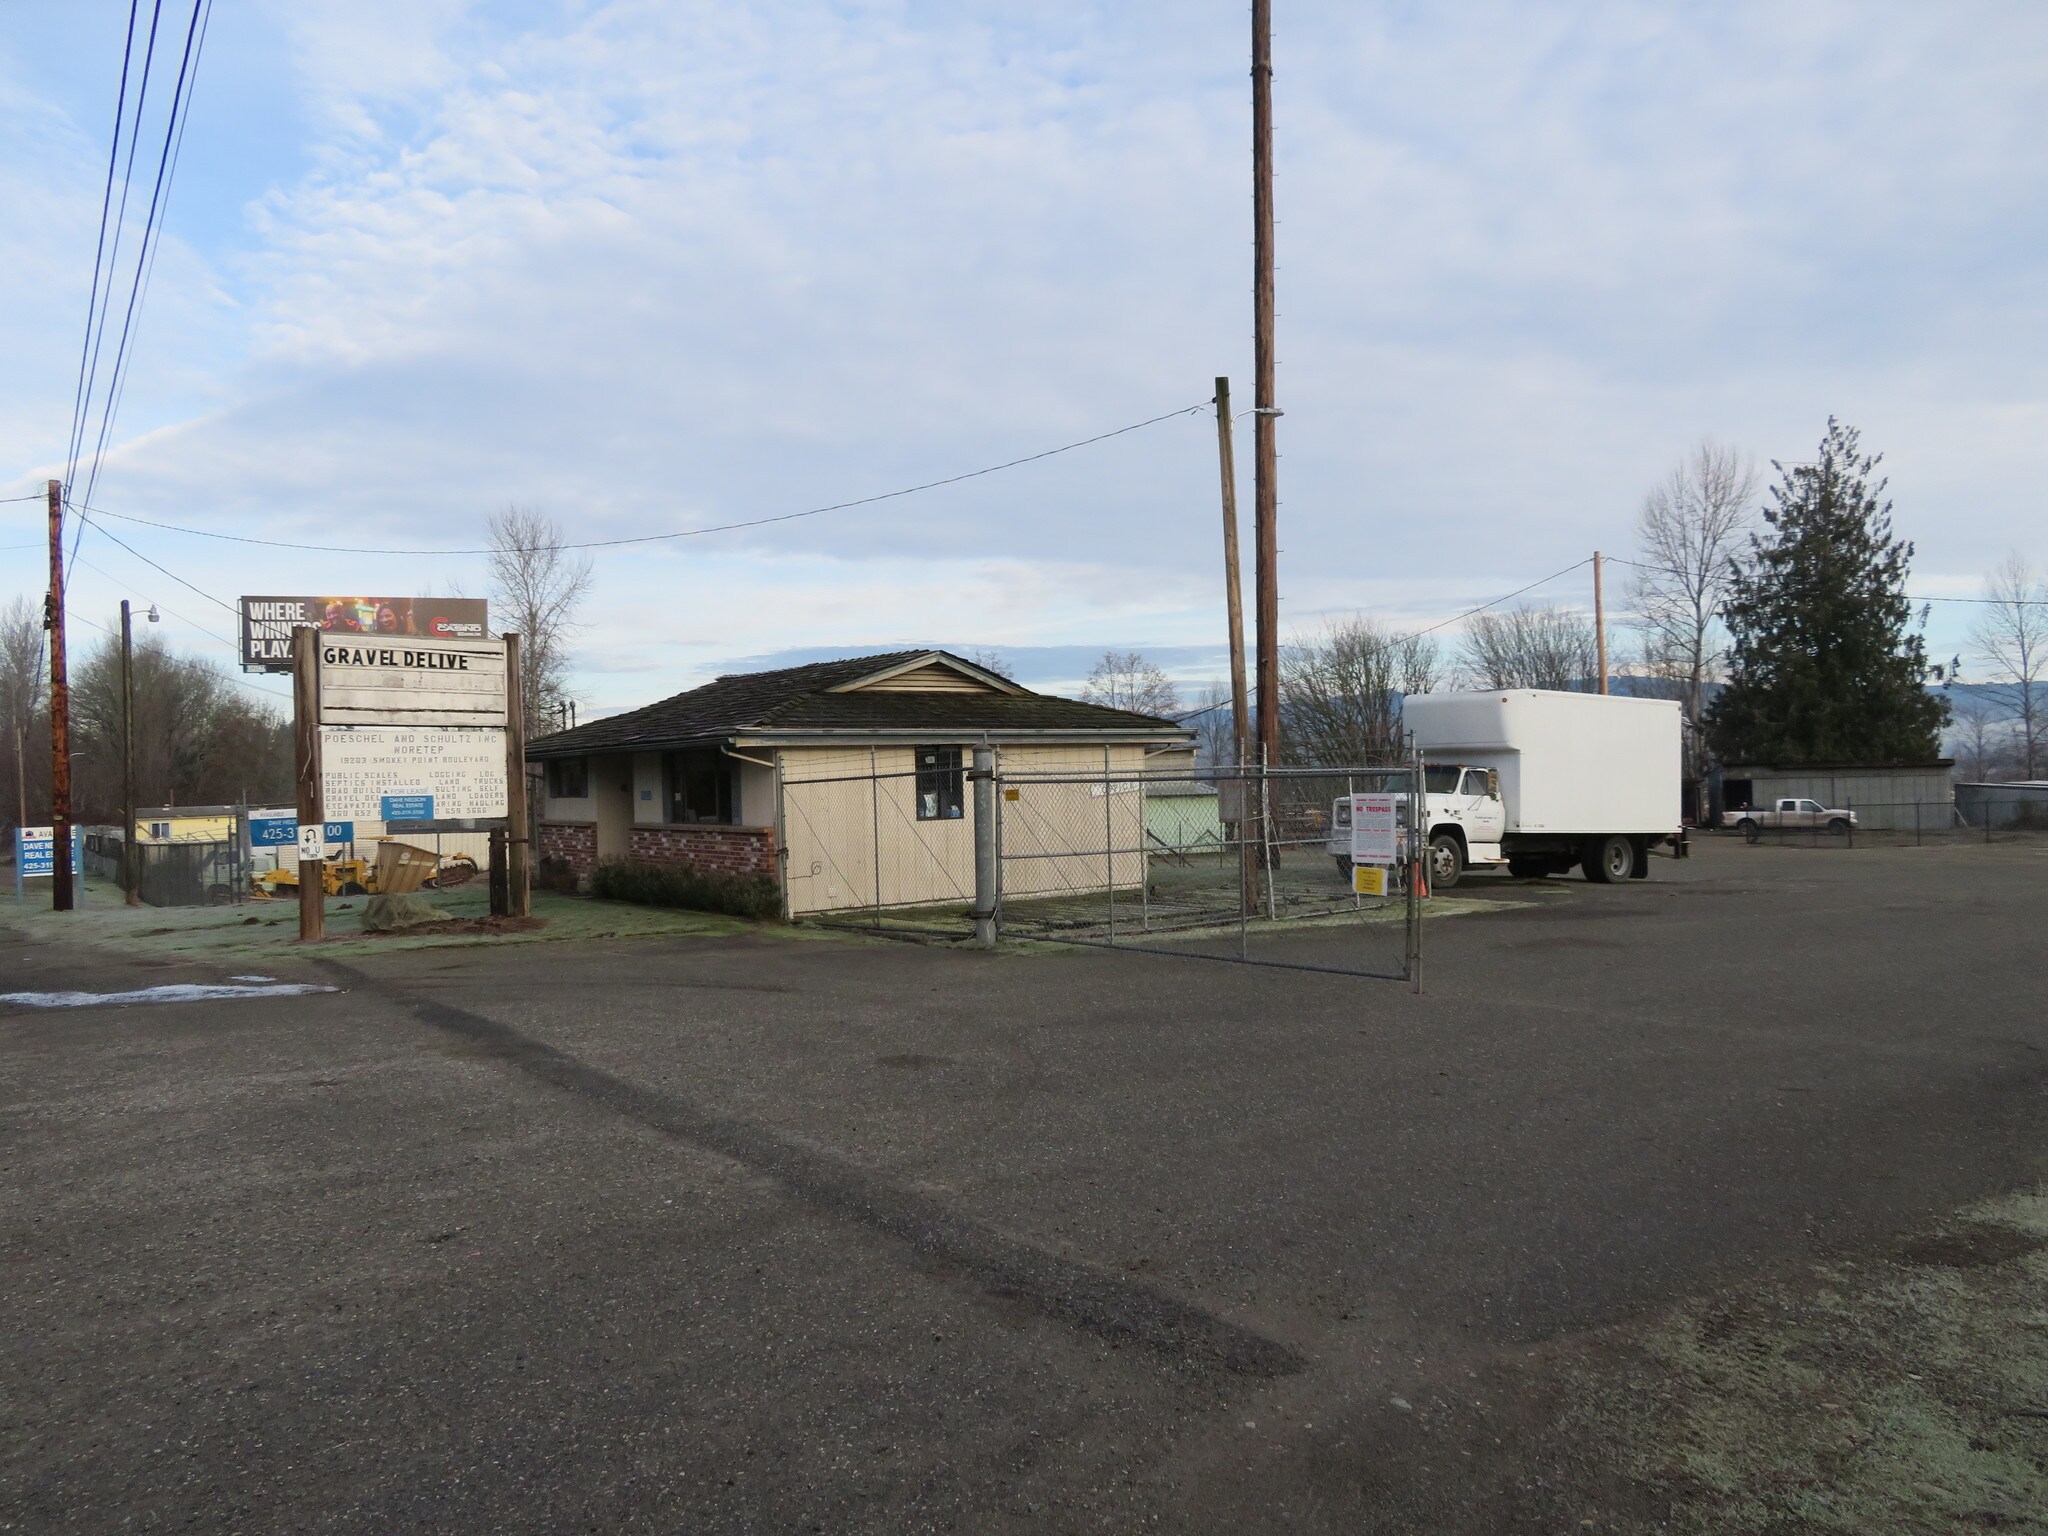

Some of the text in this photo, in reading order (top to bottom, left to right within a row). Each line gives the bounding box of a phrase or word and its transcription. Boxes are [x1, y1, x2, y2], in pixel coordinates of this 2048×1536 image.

[249, 602, 305, 620] WHERE
[249, 621, 322, 639] WINN
[250, 640, 293, 658] PLAY.
[323, 647, 469, 670] GRAVEL DELIVE
[325, 734, 497, 743] POESCHEL AND SCHULTZ INC
[394, 745, 444, 754] NORETEP
[412, 756, 438, 764] POINT
[364, 771, 398, 779] SCALES
[325, 794, 360, 802] GRAVEL
[23, 842, 44, 850] DAVE
[24, 851, 45, 859] REAL
